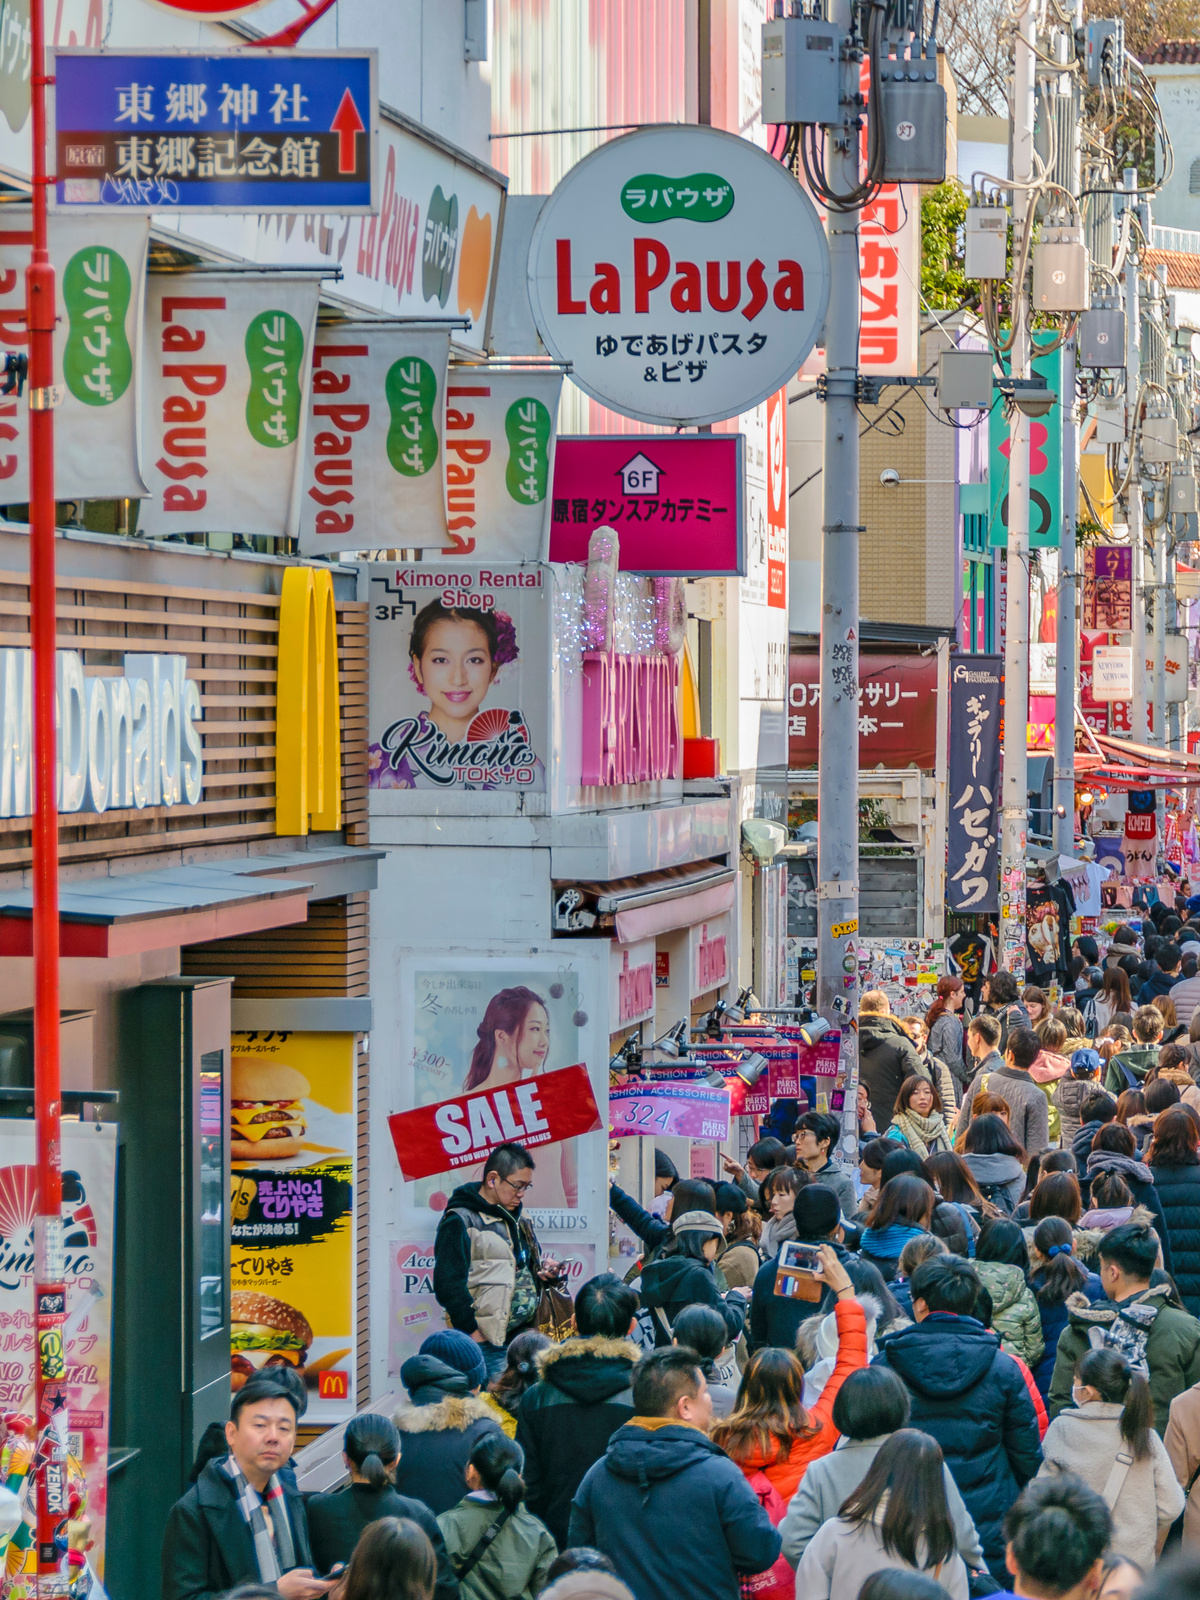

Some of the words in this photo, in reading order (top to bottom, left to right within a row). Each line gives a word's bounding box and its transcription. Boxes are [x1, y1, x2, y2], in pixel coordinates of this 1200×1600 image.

[114, 82, 311, 124] 東郷神社
[114, 137, 321, 178] 東郷記念館
[625, 186, 730, 210] ラパウザ
[556, 239, 621, 315] La
[634, 238, 804, 322] Pausa
[83, 253, 113, 401] ラパウザ
[161, 297, 227, 352] La
[595, 333, 768, 358] ゆであげパスタ
[262, 316, 288, 445] ラパウザ
[312, 345, 370, 394] La
[643, 360, 708, 383] &ピザ
[402, 361, 425, 474] ラパウザ
[155, 365, 227, 512] Pausa
[520, 401, 539, 503] ラパウザ
[307, 404, 371, 534] Pausa
[627, 471, 654, 489] 6F
[553, 498, 728, 524] 原宿ダンスアカデミー
[395, 569, 473, 588] Kimono
[479, 569, 542, 588] Rental
[374, 605, 404, 621] 3F
[441, 589, 495, 611] Shop
[0, 649, 202, 818] MDonald's
[381, 718, 536, 785] Kimono
[965, 693, 990, 780] ギャラリー
[452, 767, 534, 783] TOKYO
[951, 784, 996, 909] ハセガワ
[1126, 850, 1153, 863] うどん
[651, 1086, 723, 1102] ACCESSORIES
[435, 1082, 550, 1156] SALE
[460, 1153, 474, 1164] YOU
[527, 1131, 552, 1145] VALUES
[258, 1180, 322, 1197] 売上No.1
[258, 1195, 324, 1219] てりやき
